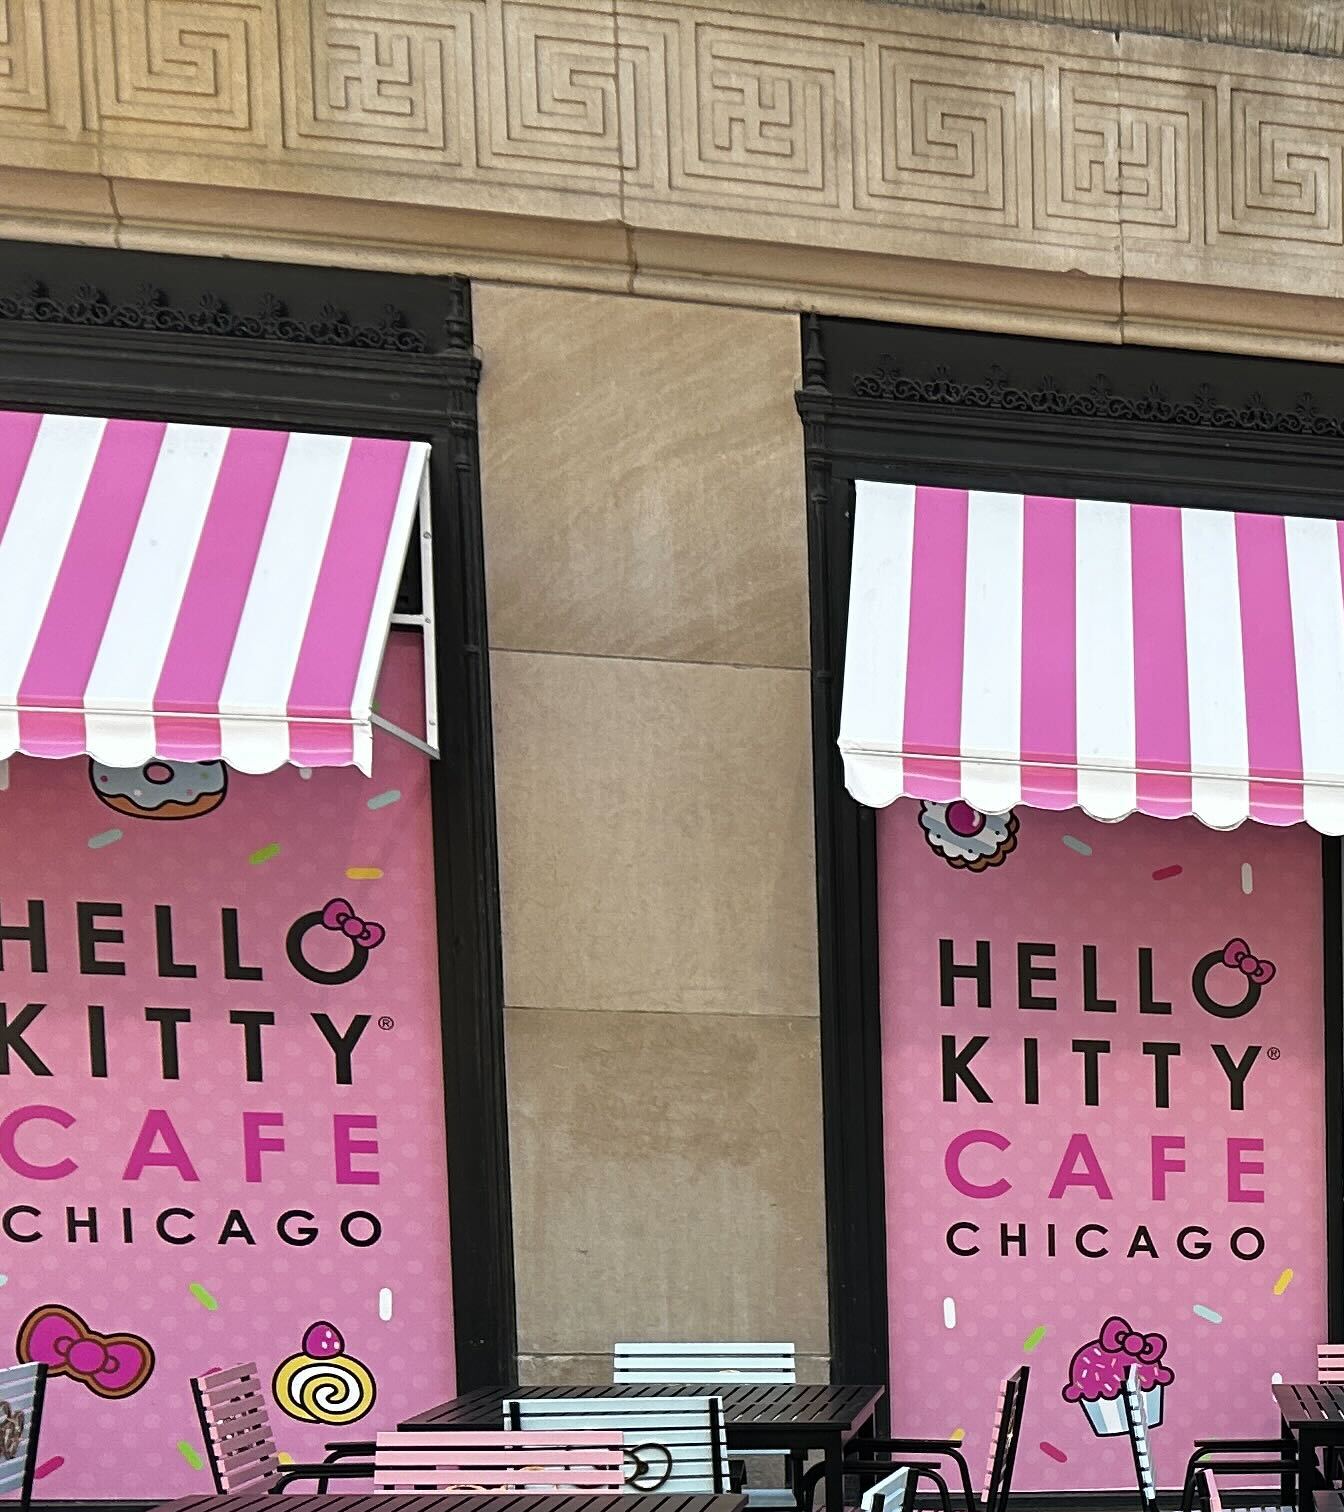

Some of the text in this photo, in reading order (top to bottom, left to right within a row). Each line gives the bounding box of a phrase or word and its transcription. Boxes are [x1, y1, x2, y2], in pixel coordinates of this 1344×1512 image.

[0, 899, 372, 985] HELLO
[939, 939, 1268, 1018] HELLO
[0, 1105, 380, 1185] CAFE
[944, 1129, 1265, 1204] CAFE
[2, 1205, 382, 1247] CHICAGO
[946, 1221, 1265, 1260] CHICAGO
